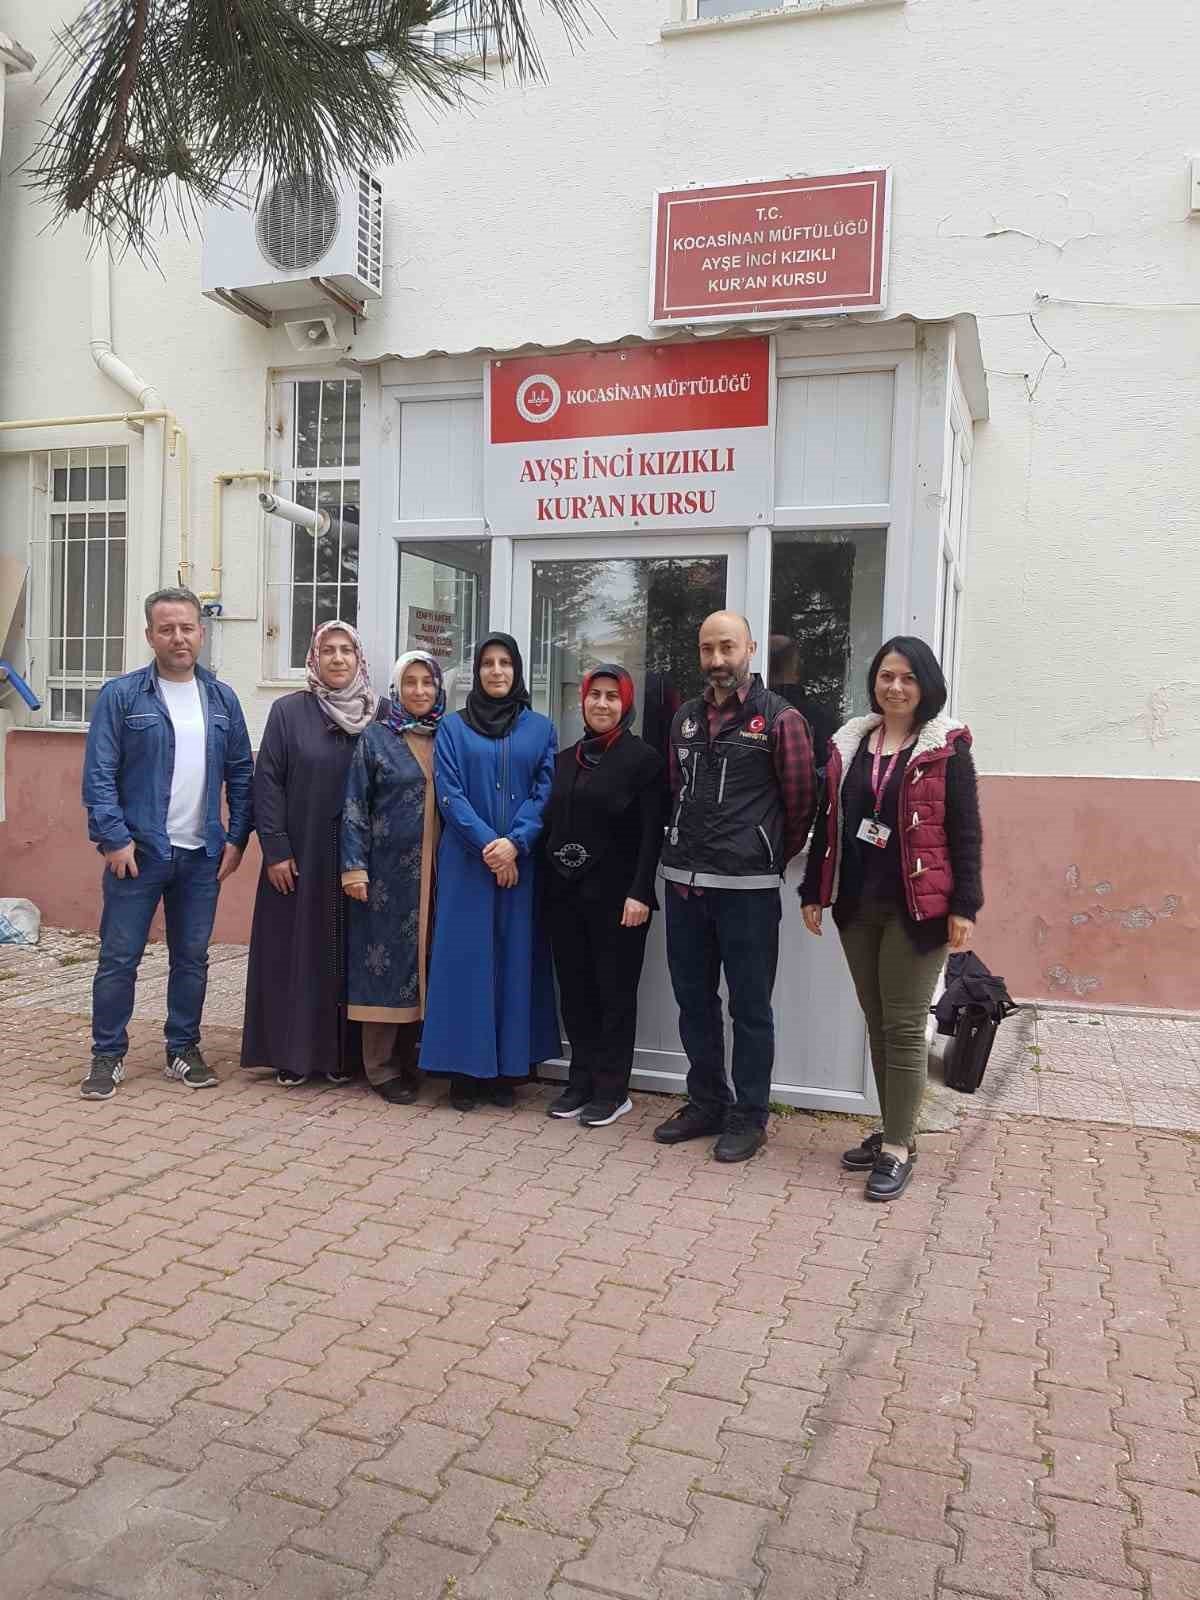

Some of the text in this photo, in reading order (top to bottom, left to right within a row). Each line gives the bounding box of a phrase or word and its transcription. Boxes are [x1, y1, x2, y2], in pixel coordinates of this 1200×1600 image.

[756, 206, 783, 220] T.C.
[673, 219, 868, 250] KOCASİNAN MÜFTÜLÜĞÜ
[702, 247, 836, 272] AYŞE İNCİ KIZIKLI
[709, 271, 827, 293] KUR’AN KURSU
[566, 382, 651, 405] KOCASİNAN
[655, 373, 752, 397] MÜFTÜLÜĞÜ
[520, 447, 736, 488] AYŞE İNCİ KIZIKLI
[537, 490, 716, 521] KUR’AN KURSU
